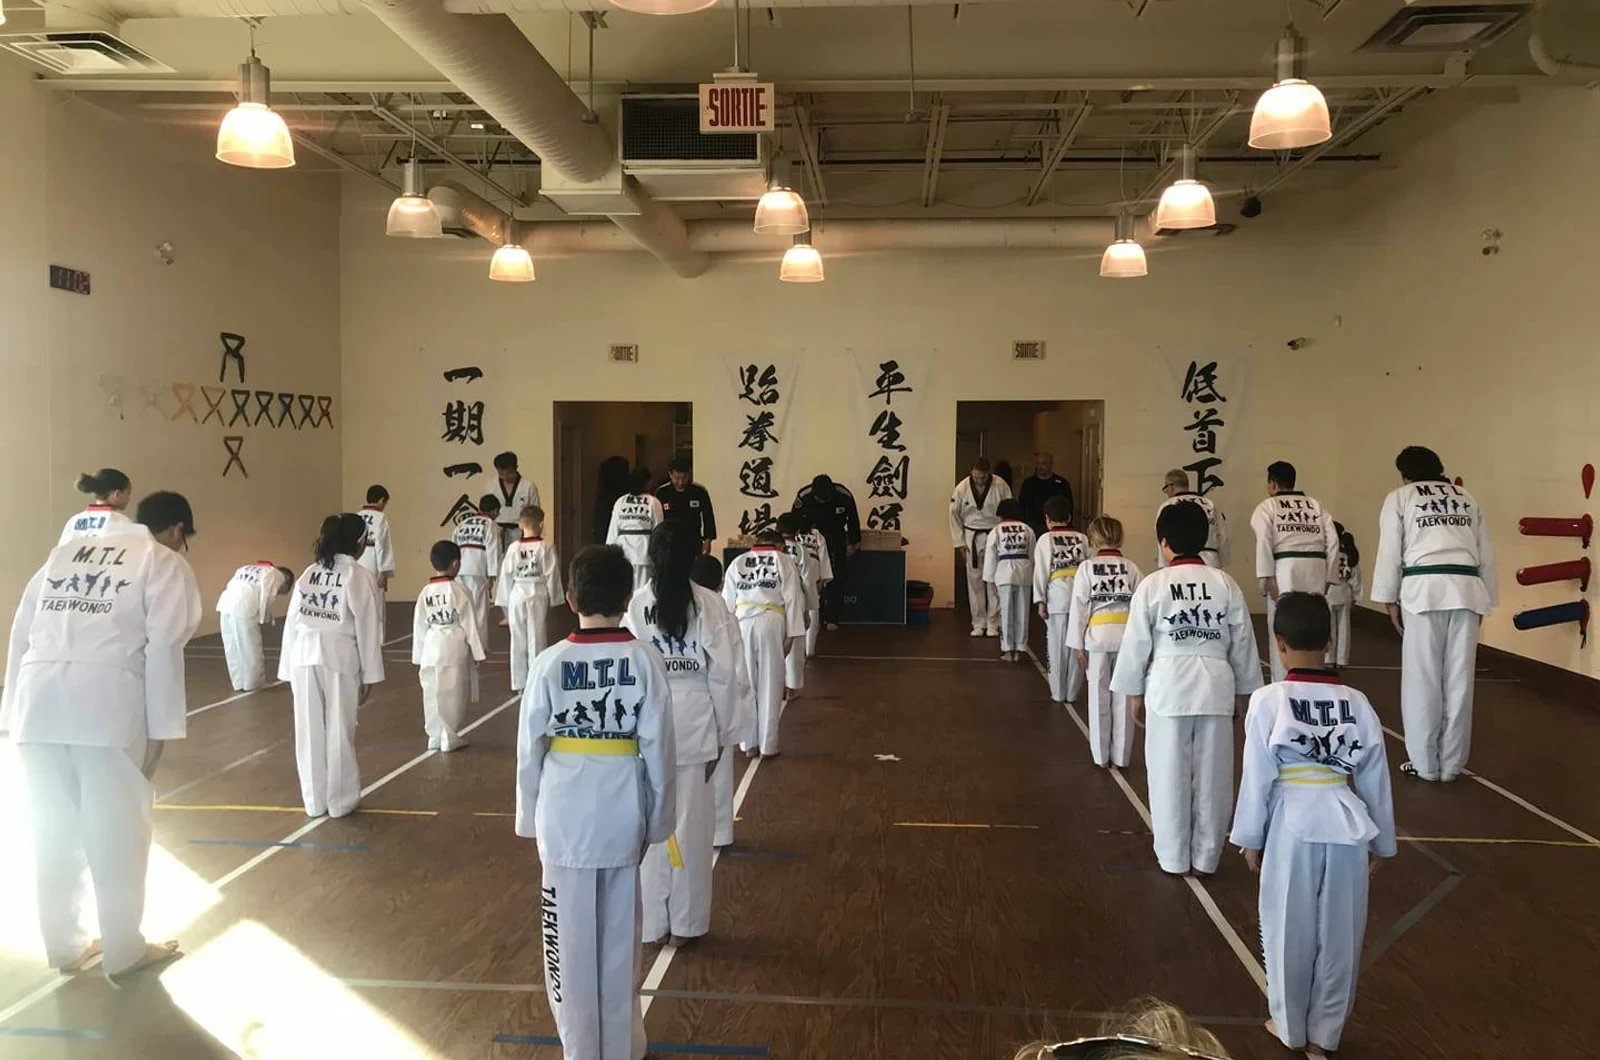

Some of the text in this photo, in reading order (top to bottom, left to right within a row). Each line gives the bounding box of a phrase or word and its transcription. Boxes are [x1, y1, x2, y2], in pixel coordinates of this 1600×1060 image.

[708, 87, 766, 127] SORTIE
[1415, 484, 1464, 497] M.T.L
[1277, 524, 1321, 535] TAEKWONDO
[1416, 515, 1472, 528] TAEKWONDO
[72, 546, 127, 566] M.T.L
[309, 572, 342, 587] M.T.L
[1170, 582, 1212, 601] M.T.L
[1169, 629, 1222, 642] TAEKWONDO
[561, 656, 636, 691] M.T.L
[1288, 697, 1357, 727] M.T.L
